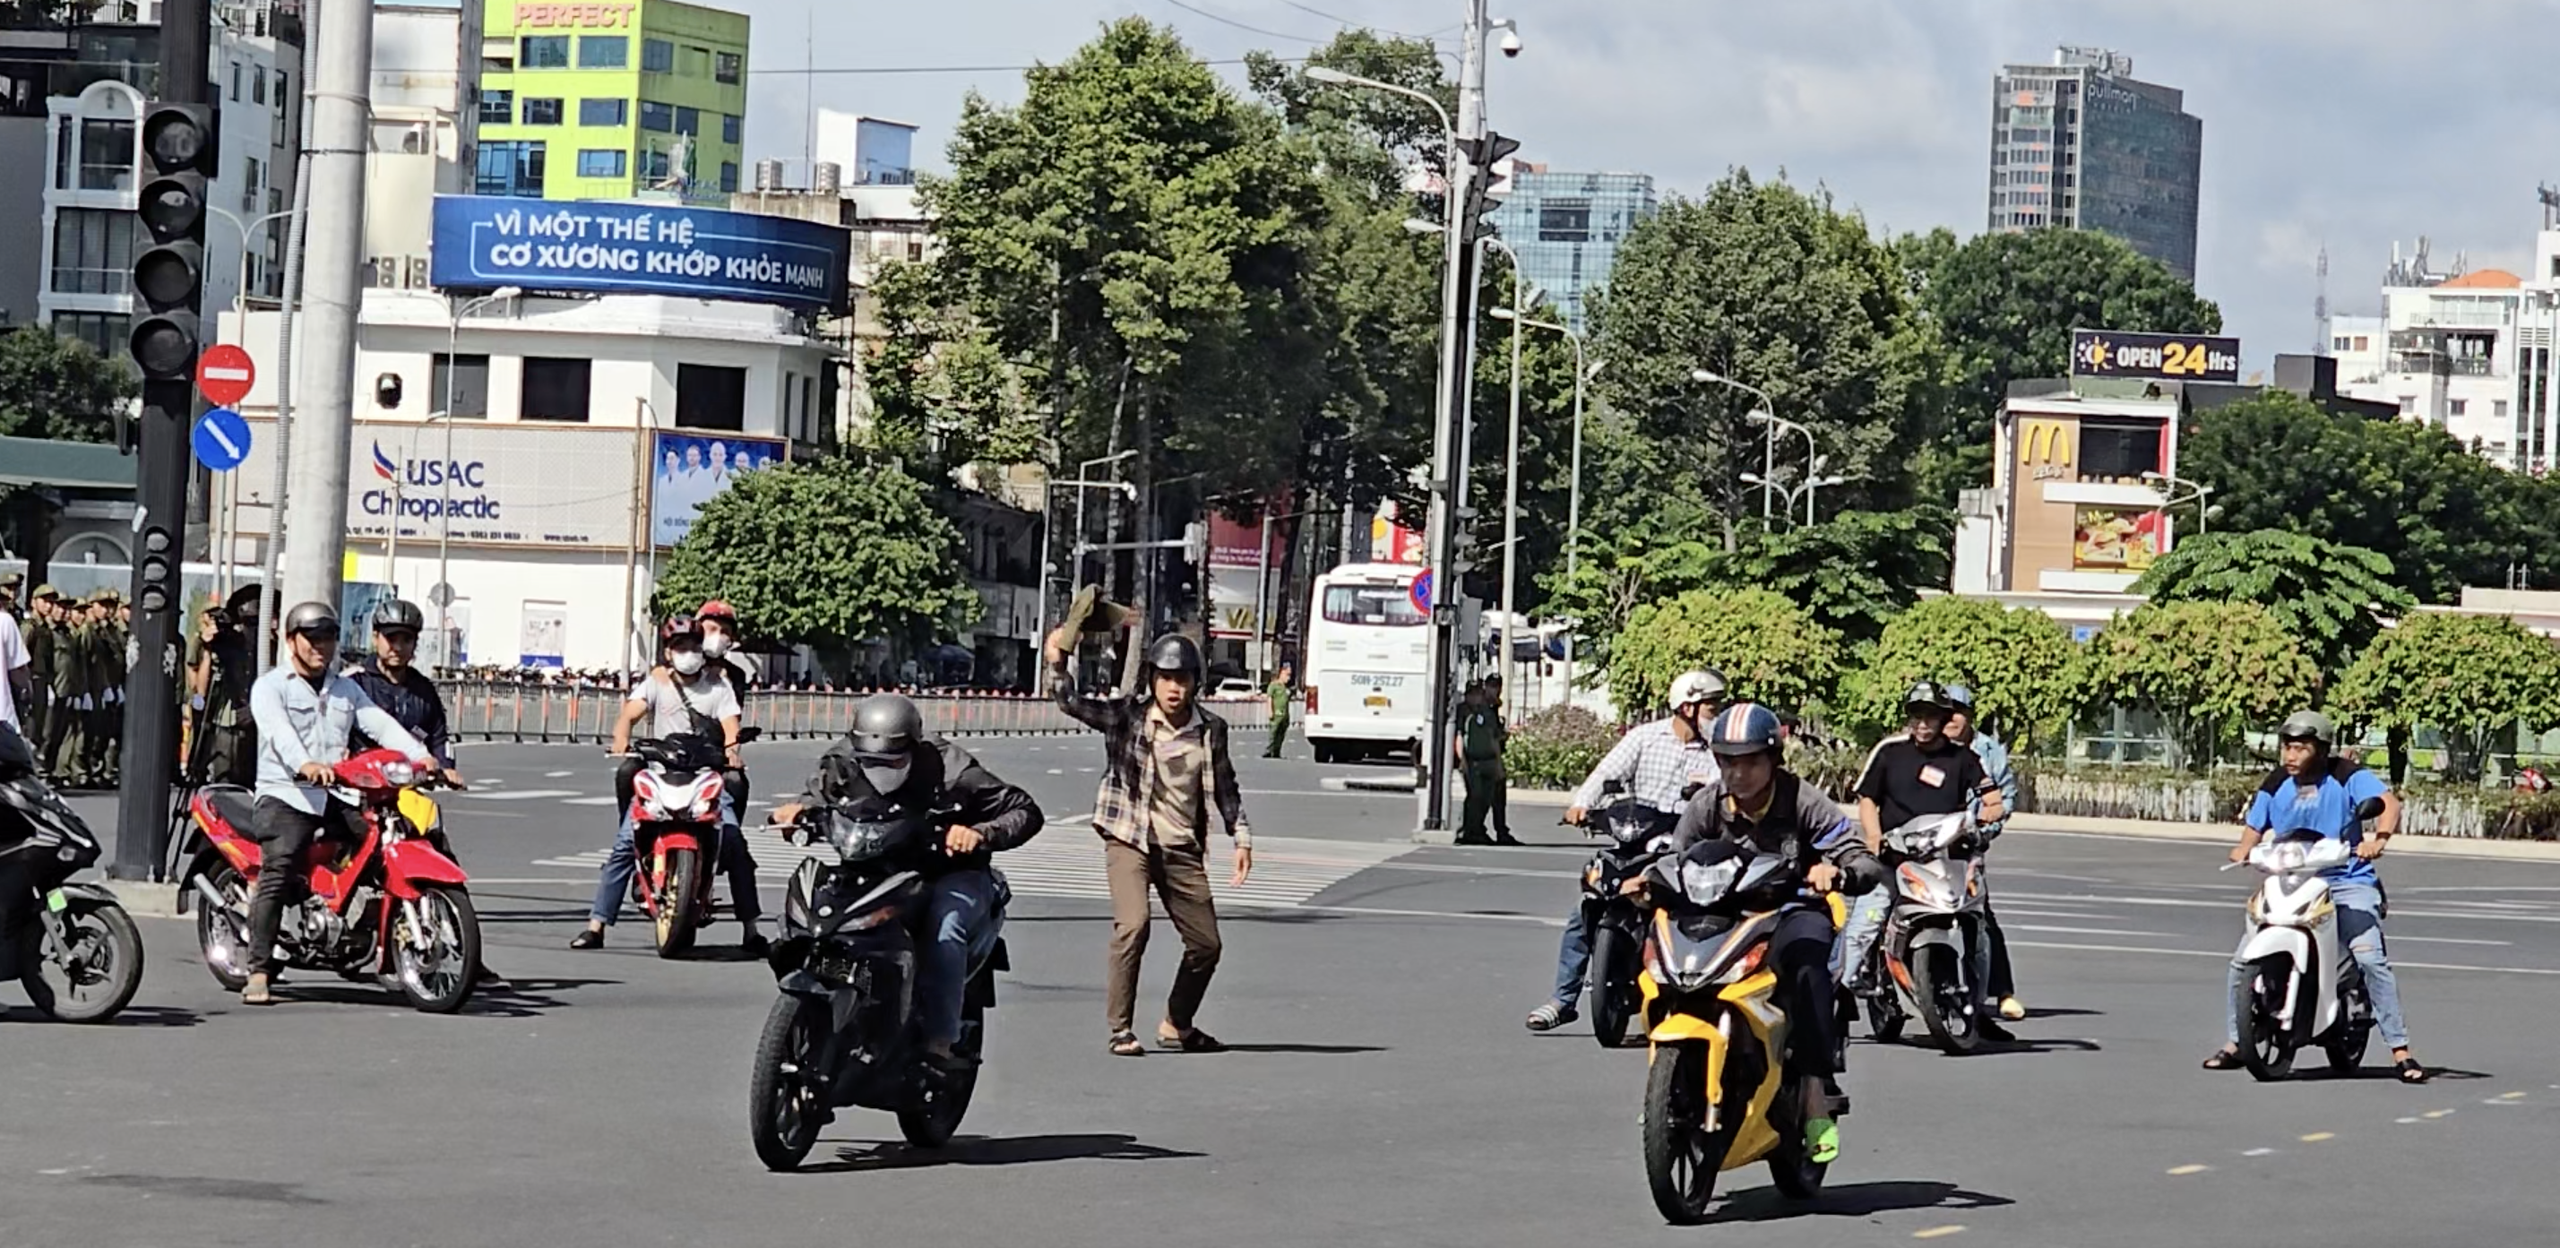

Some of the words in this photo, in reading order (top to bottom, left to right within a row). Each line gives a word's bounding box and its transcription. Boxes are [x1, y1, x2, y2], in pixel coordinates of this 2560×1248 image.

[514, 3, 635, 28] PERFECT
[2087, 84, 2137, 111] pullman
[494, 208, 521, 236] VÌ
[529, 210, 591, 242] MỘT
[596, 212, 653, 241] THẾ
[658, 217, 694, 249] HỆ
[490, 241, 531, 267] CƠ
[536, 242, 639, 272] XƯƠNG
[646, 249, 721, 277] KHỚP
[725, 253, 782, 283] KHỎE
[785, 263, 824, 290] MẠNH
[2117, 347, 2161, 368] OPEN
[2162, 342, 2207, 375] 24
[2208, 351, 2236, 371] Hrs
[407, 459, 484, 488] USAC
